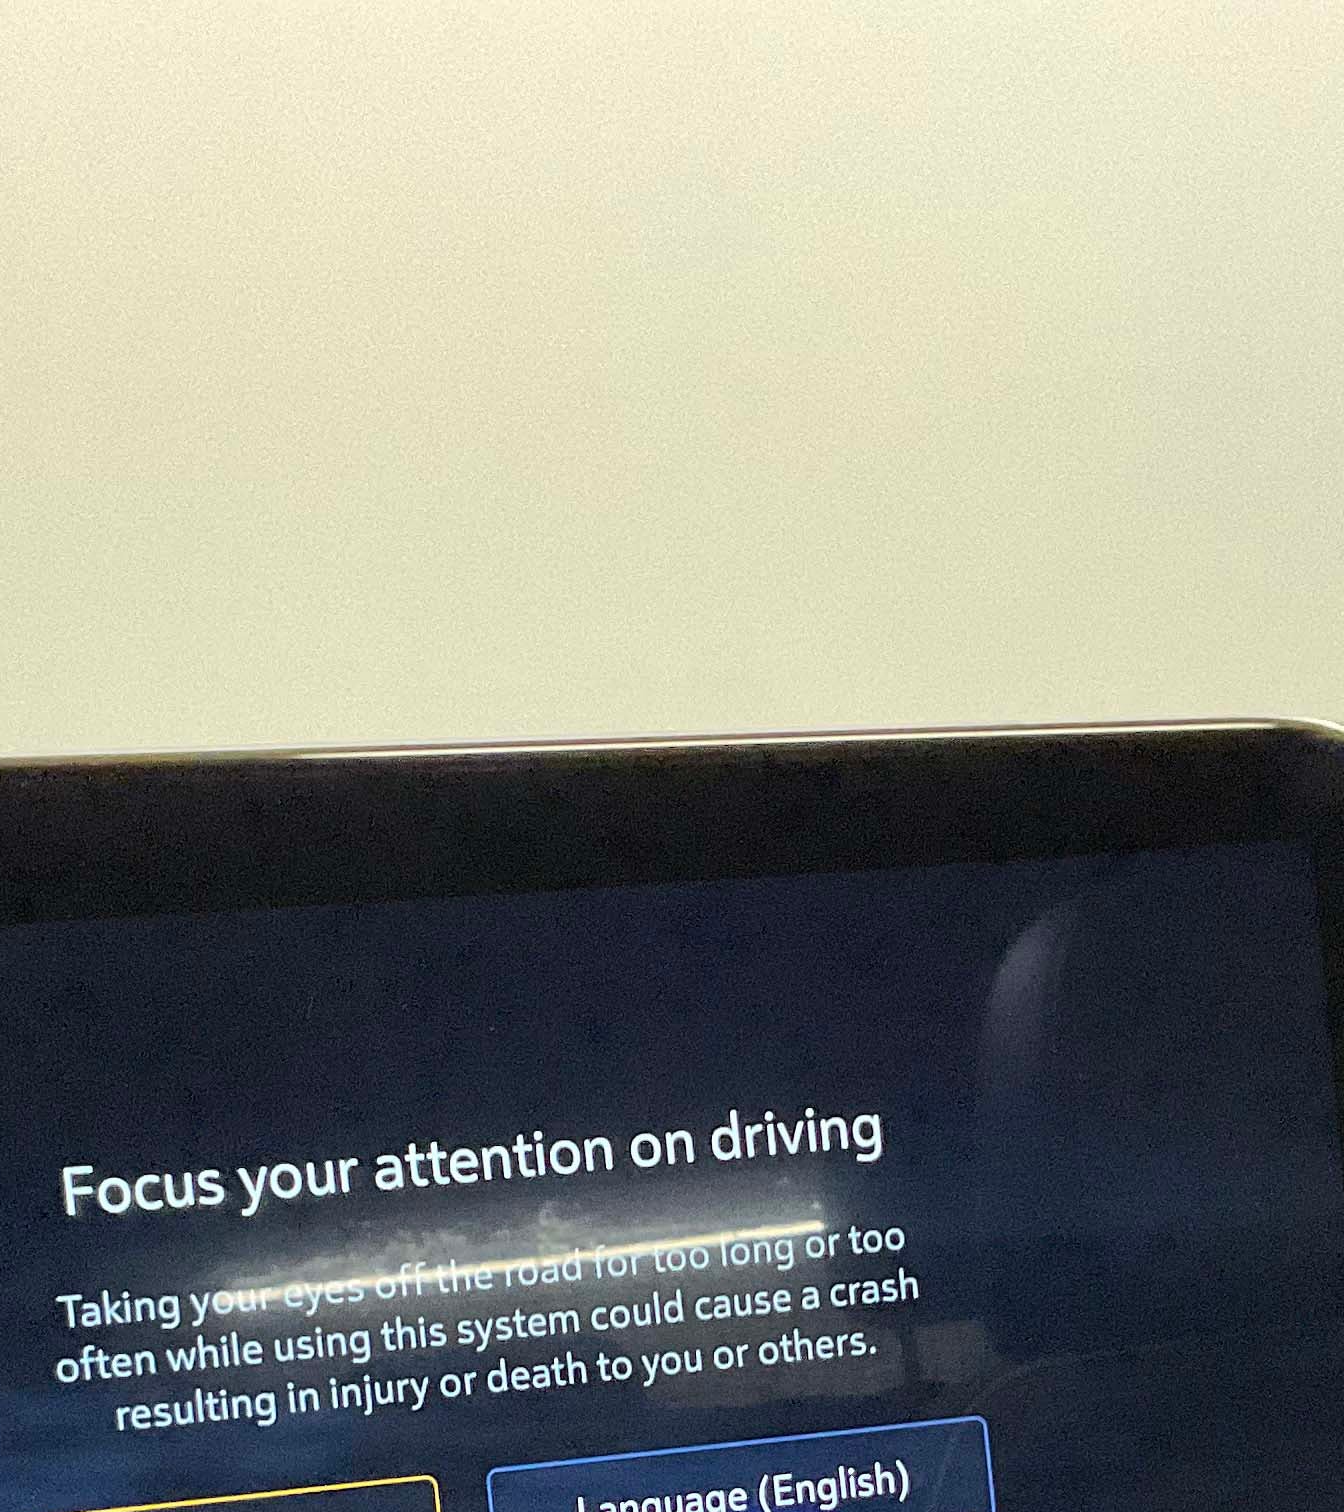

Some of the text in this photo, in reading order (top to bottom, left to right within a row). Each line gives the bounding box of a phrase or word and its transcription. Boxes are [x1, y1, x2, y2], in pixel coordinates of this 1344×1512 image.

[61, 1106, 884, 1218] Focus your attention on driving
[54, 1223, 906, 1330] Taking your eyes off the road for too long or too
[55, 1266, 920, 1384] often while using this system could cause a crash
[115, 1326, 878, 1432] resulting in injury or death to you or others.
